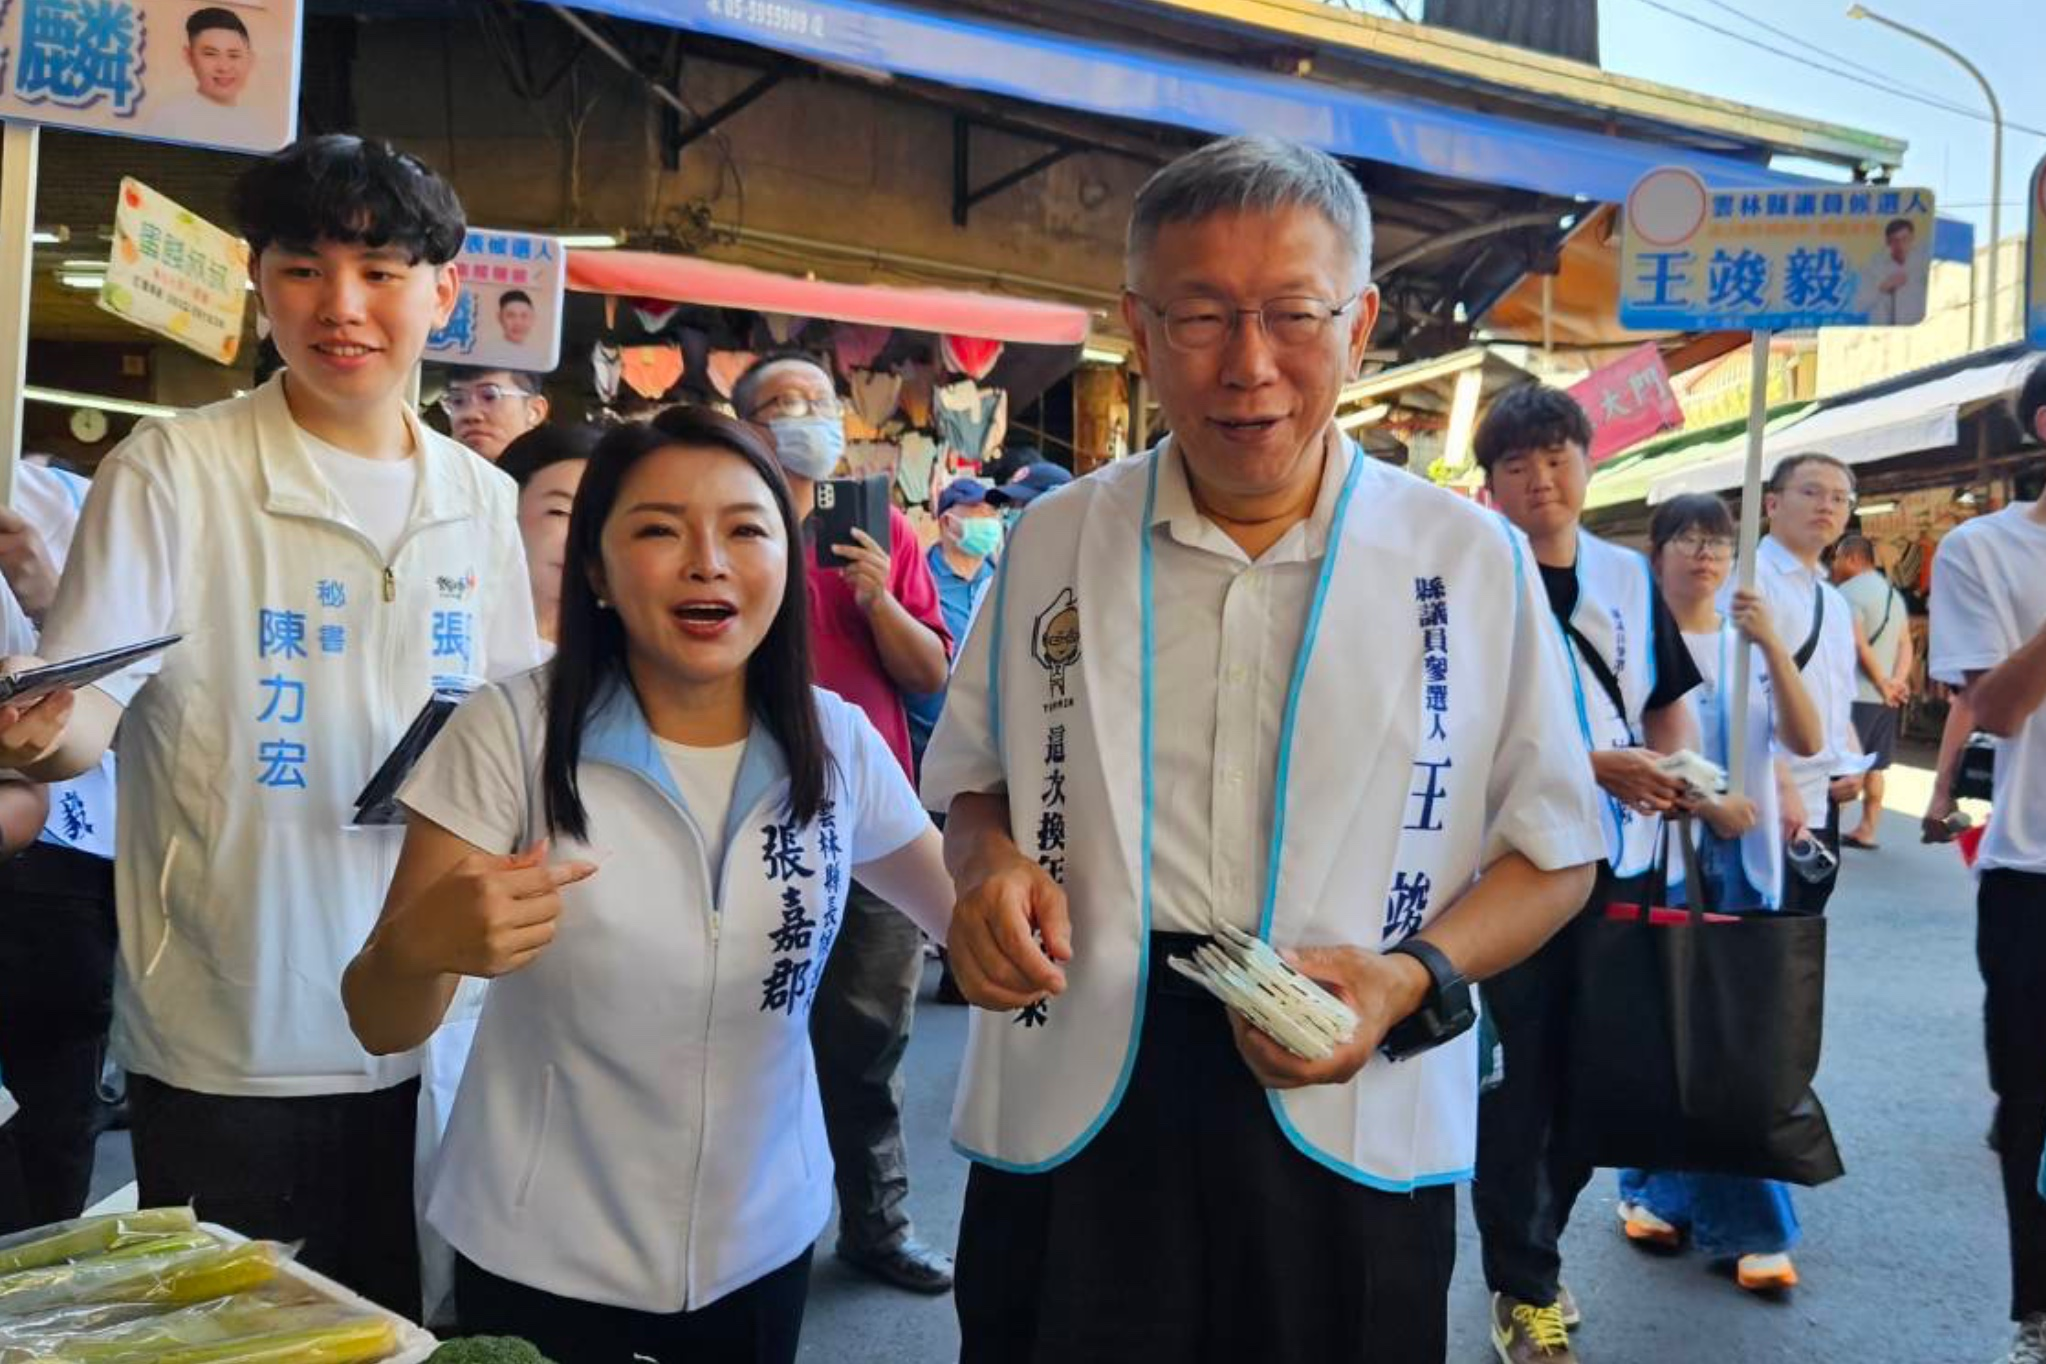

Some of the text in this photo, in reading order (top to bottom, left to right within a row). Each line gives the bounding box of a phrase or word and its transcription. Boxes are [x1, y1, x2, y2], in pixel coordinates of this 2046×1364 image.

[1712, 192, 1929, 218] 雲林縣議員候選人
[1632, 247, 1846, 307] 王竣毅
[316, 579, 346, 653] 秘書
[257, 607, 307, 789] 陳力宏
[759, 822, 816, 1016] 張嘉郡
